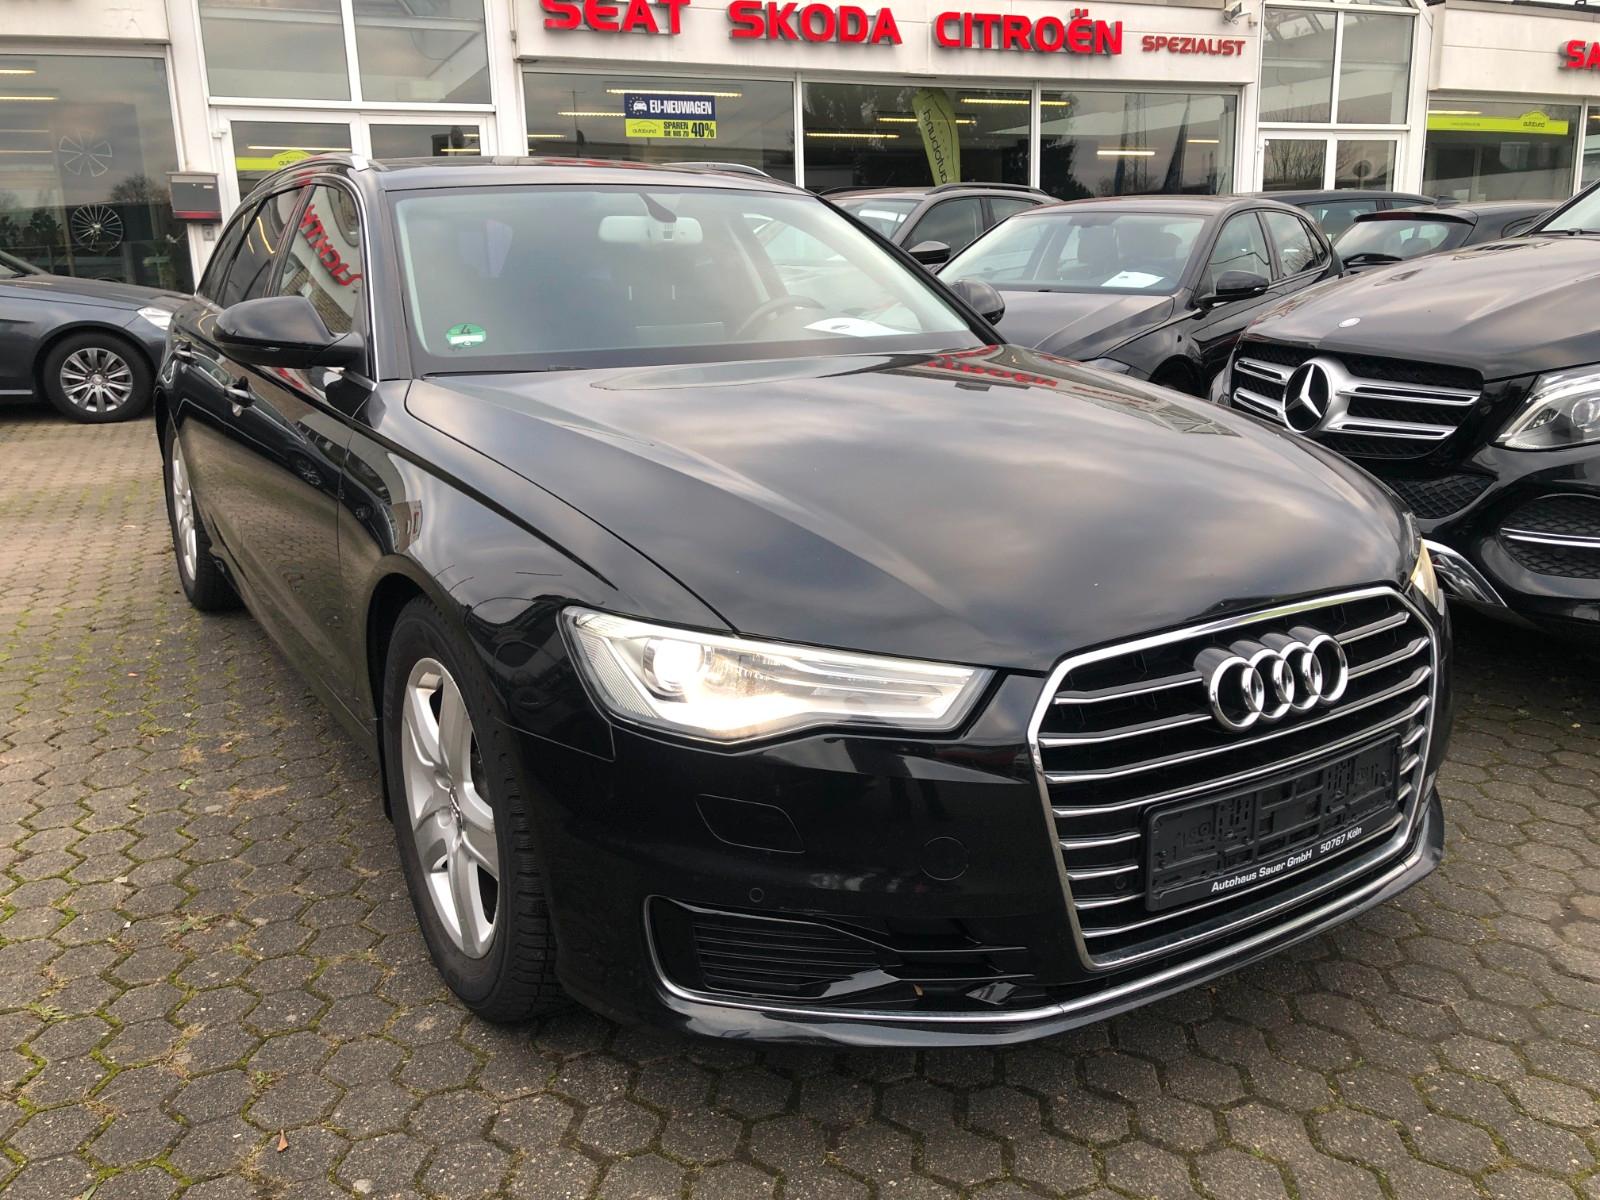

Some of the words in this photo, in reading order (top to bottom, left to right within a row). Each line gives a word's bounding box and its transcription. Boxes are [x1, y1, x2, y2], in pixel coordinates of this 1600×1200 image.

[539, 0, 691, 36] SEAT
[728, 1, 903, 45] SKODA
[934, 8, 1123, 55] CITROËN
[1142, 35, 1246, 56] SPEZIALIST
[650, 100, 712, 114] EU-NEUWAGEN
[663, 121, 689, 130] SPAREN
[691, 122, 715, 138] 40%
[1211, 873, 1257, 892] Autohaus
[1259, 862, 1286, 877] Sauer
[1287, 849, 1312, 867] GmbH
[1320, 834, 1346, 853] 50767
